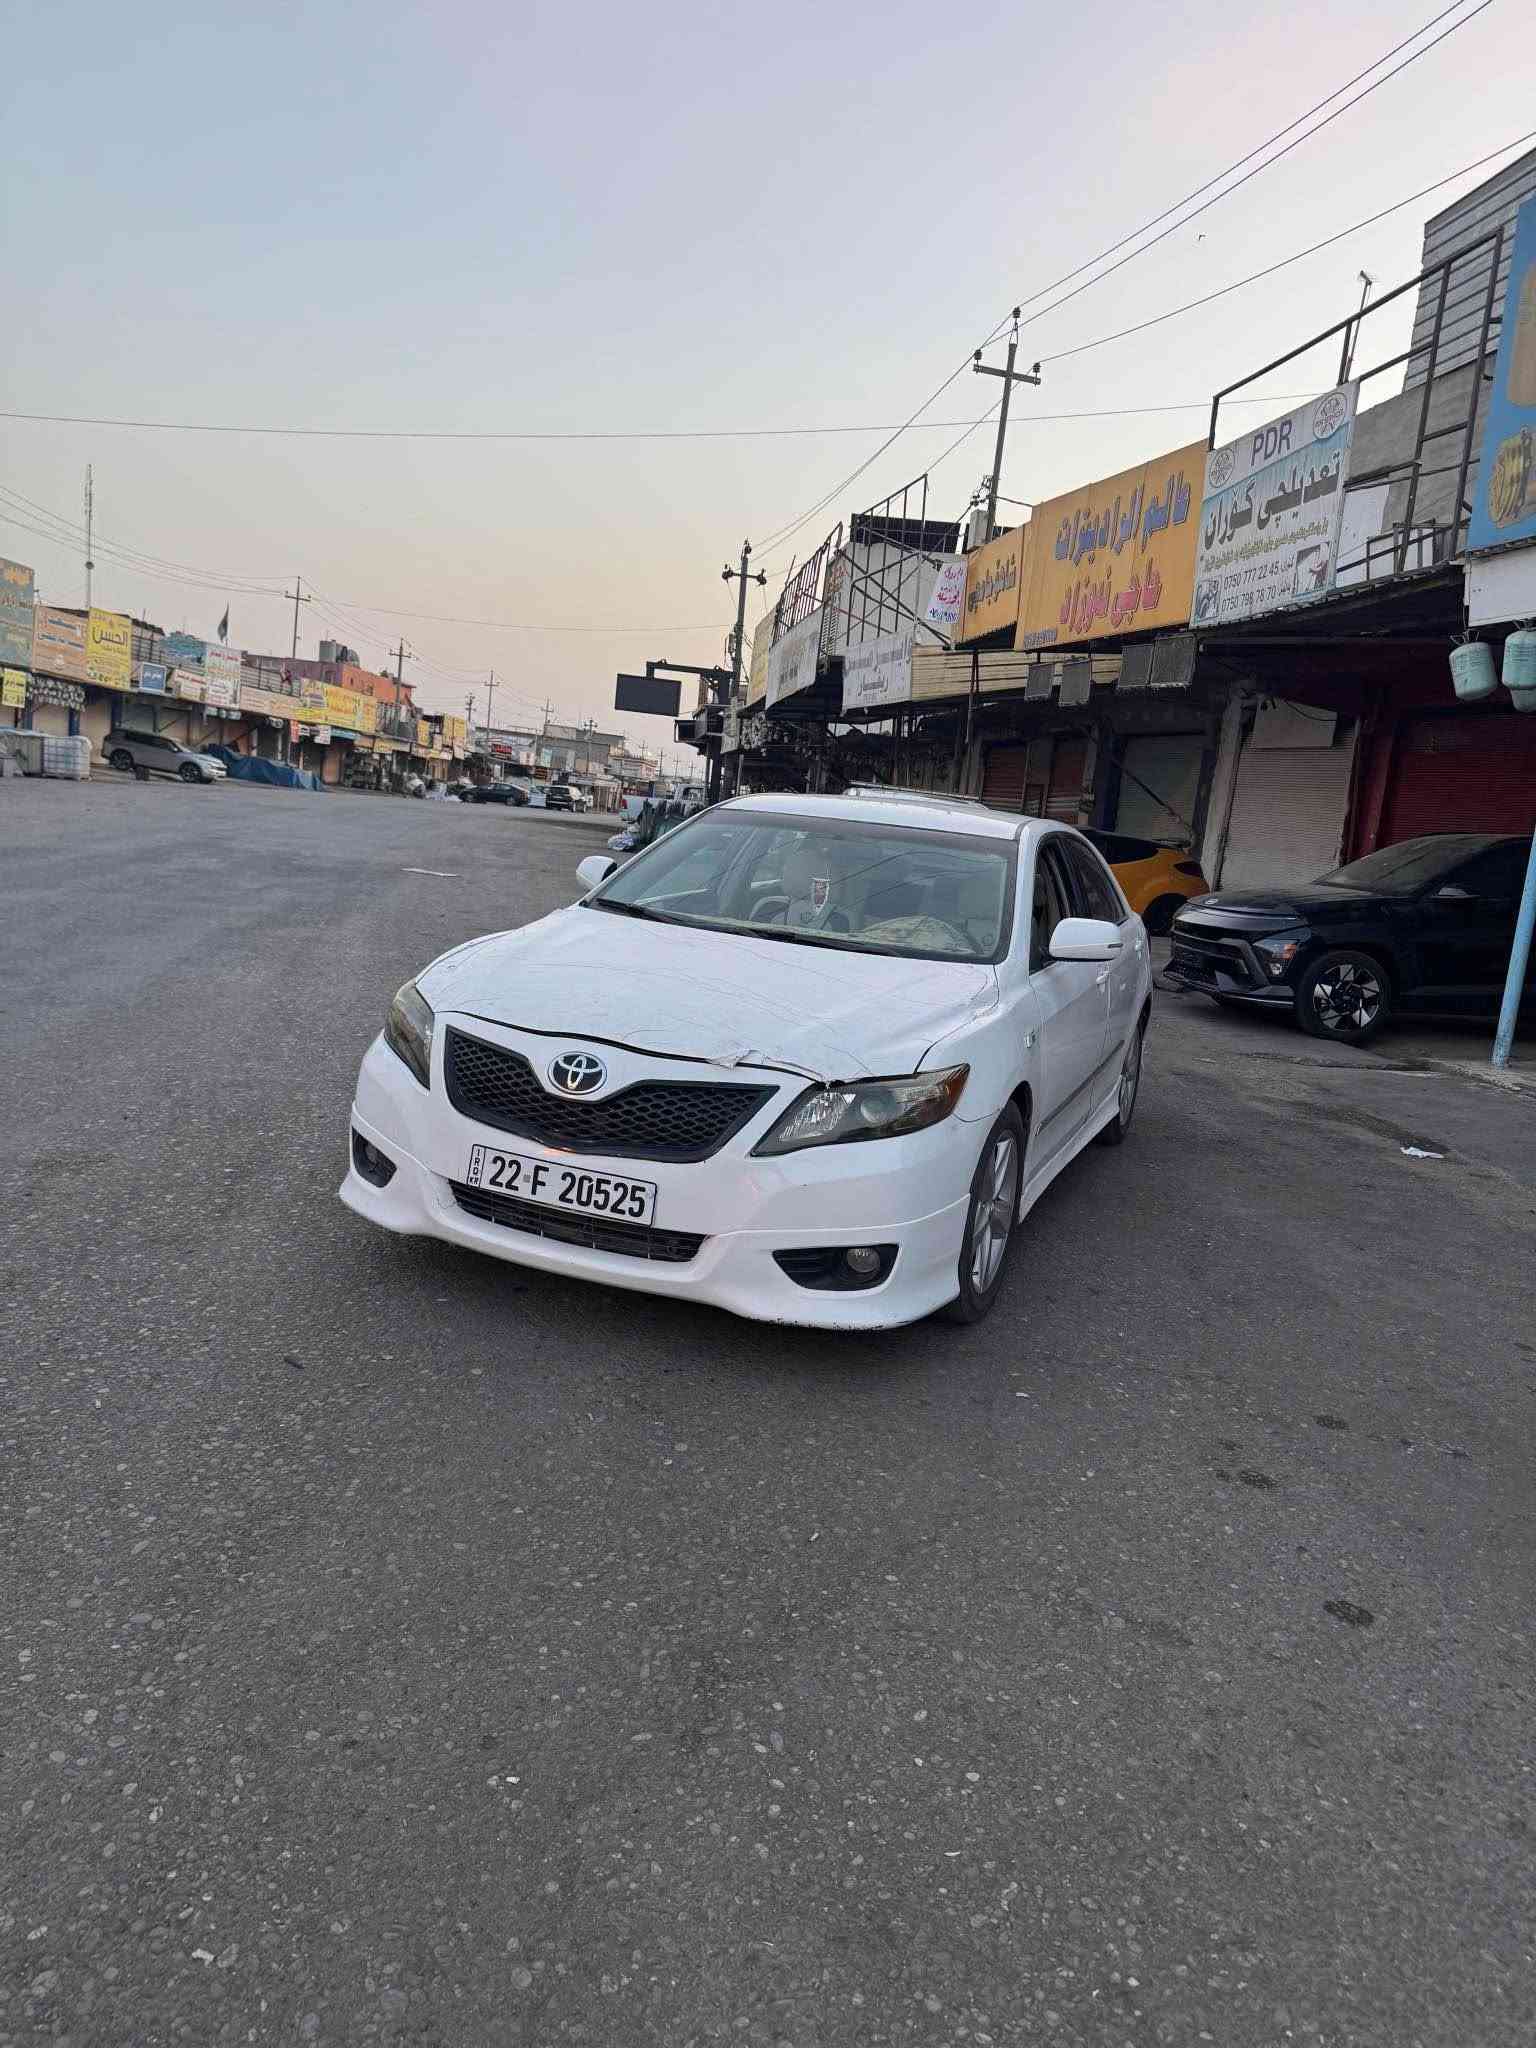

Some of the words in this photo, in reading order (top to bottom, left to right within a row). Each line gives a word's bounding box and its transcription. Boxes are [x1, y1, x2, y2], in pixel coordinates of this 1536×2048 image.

[1250, 419, 1293, 467] PDR
[489, 1155, 522, 1192] 22
[530, 1164, 550, 1196] F
[558, 1171, 646, 1218] 20525
